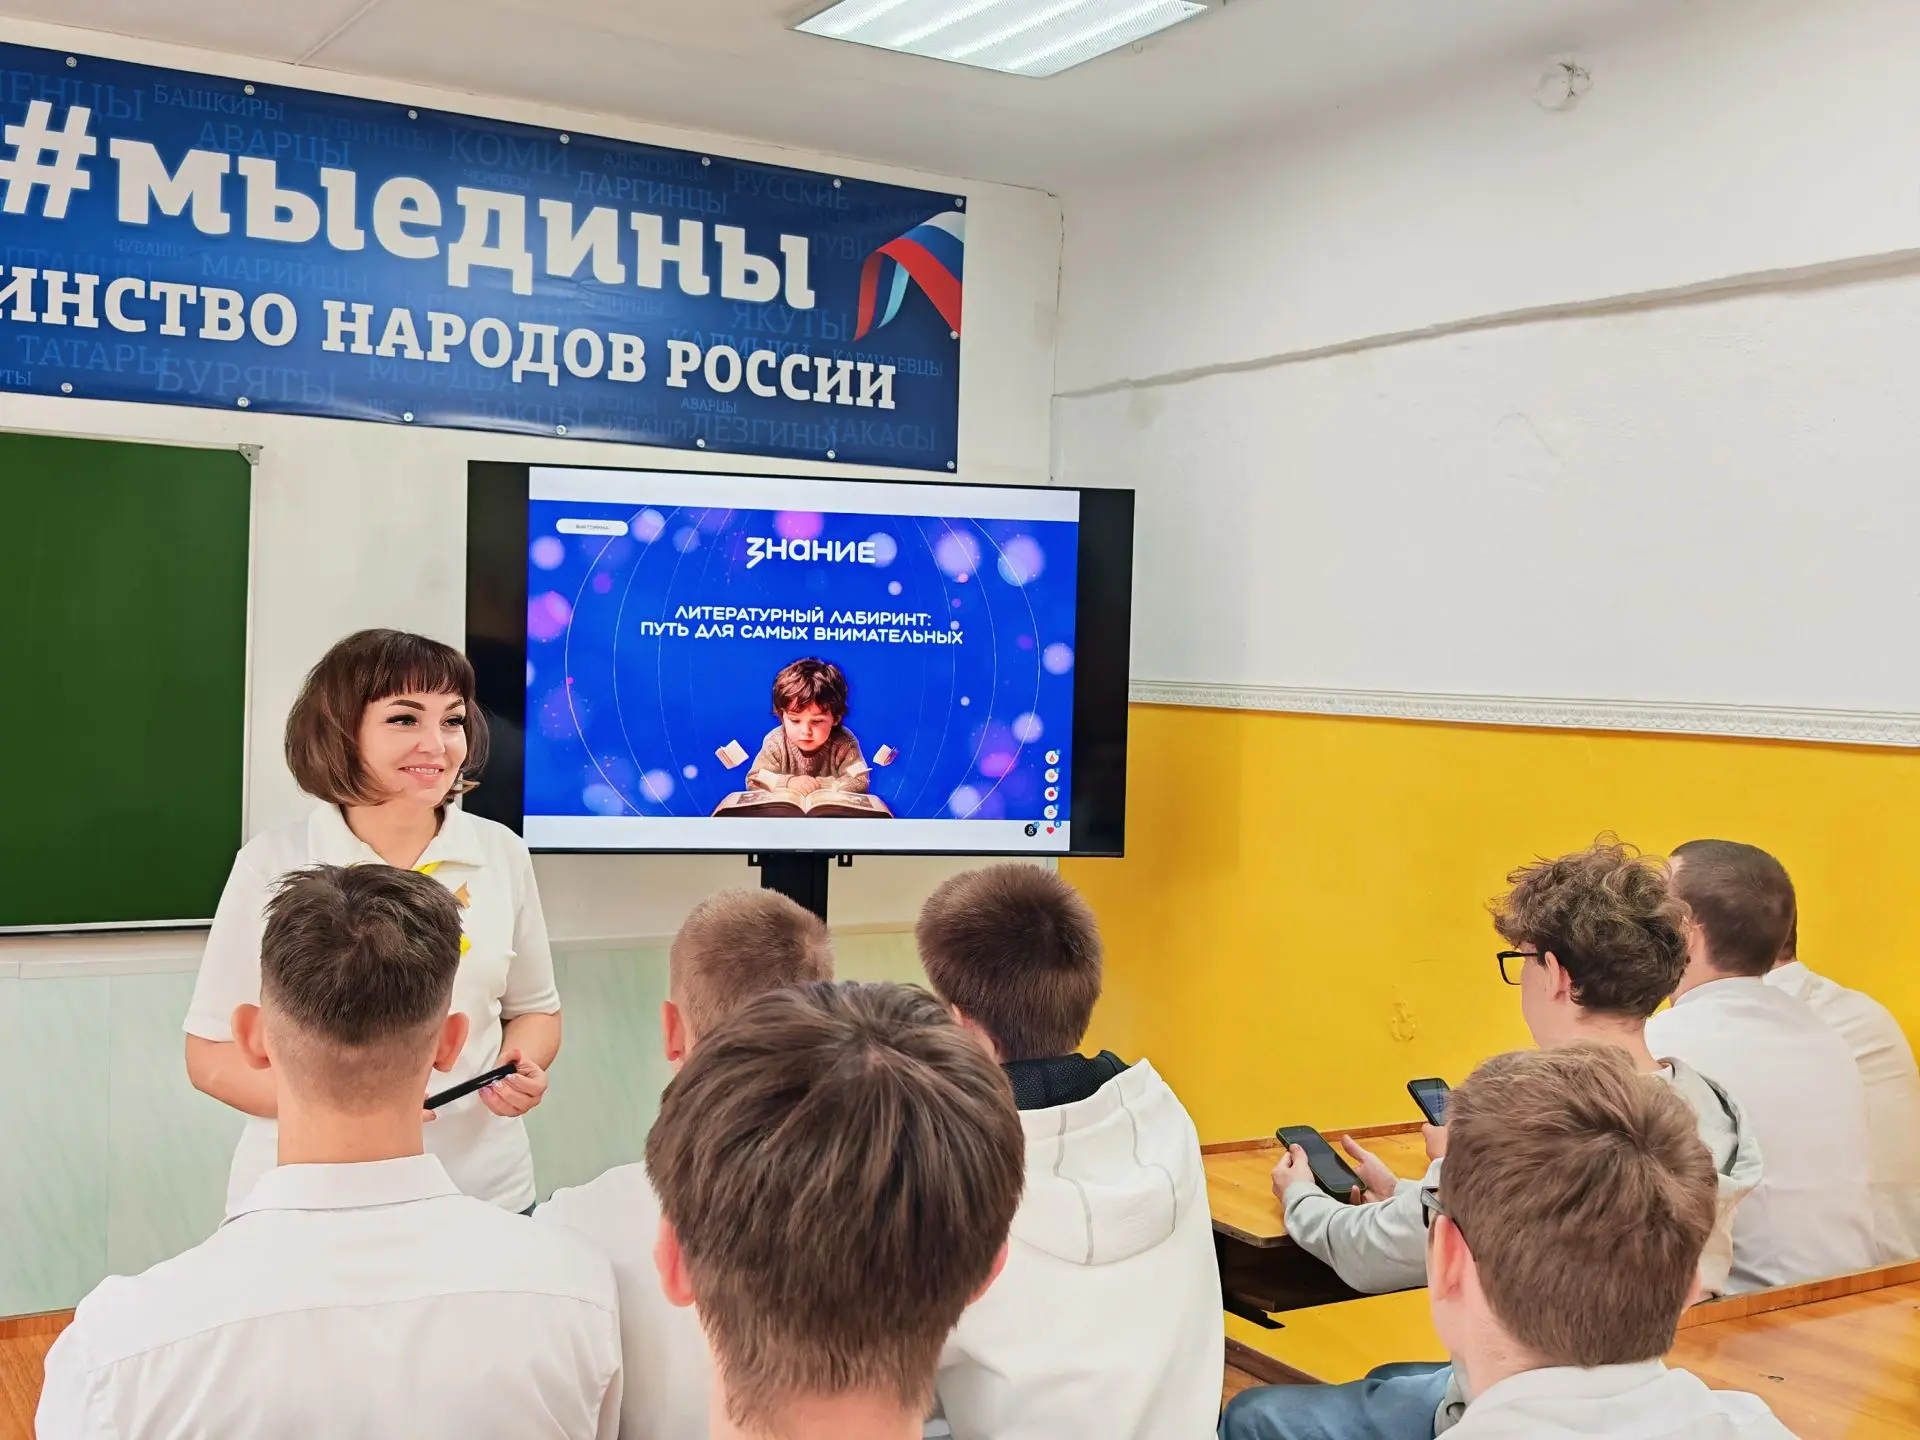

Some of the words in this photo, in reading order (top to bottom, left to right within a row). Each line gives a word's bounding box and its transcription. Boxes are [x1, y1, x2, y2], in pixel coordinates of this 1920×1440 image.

[0, 69, 144, 123] ЕНЦЫ
[152, 83, 285, 122] БАШКИРЫ
[194, 120, 353, 169] АВАРЦЫ
[448, 126, 570, 178] КОМИ
[0, 99, 816, 310] #мыедины
[574, 170, 728, 216] ДАРГИНЦЫ
[732, 169, 849, 211] РУССКИЕ
[112, 239, 185, 259] ЧУВАШИ
[201, 251, 369, 293] МАРИЙЦЫ
[731, 302, 849, 342] ЯКУТЫ
[16, 335, 168, 378] ТАТАРЫ
[321, 299, 647, 388] НАРОДОВ
[665, 339, 897, 411] РОССИИ
[156, 352, 337, 405] БУРЯТЫ
[680, 396, 737, 414] АВАРЦЫ
[691, 413, 838, 453] ЛЕЗГИНЫ
[824, 418, 937, 452] ХАКАСЫ
[640, 621, 690, 637] ПУТЬ
[694, 623, 735, 640] ДЛЯ
[740, 625, 809, 640] САМЫХ
[813, 626, 964, 645] ВНИМАТЕЛЬНЫХ
[674, 605, 824, 623] ЛИТЕРАТУРНЫЙ
[829, 609, 932, 627] ЛАБИРИНТ:
